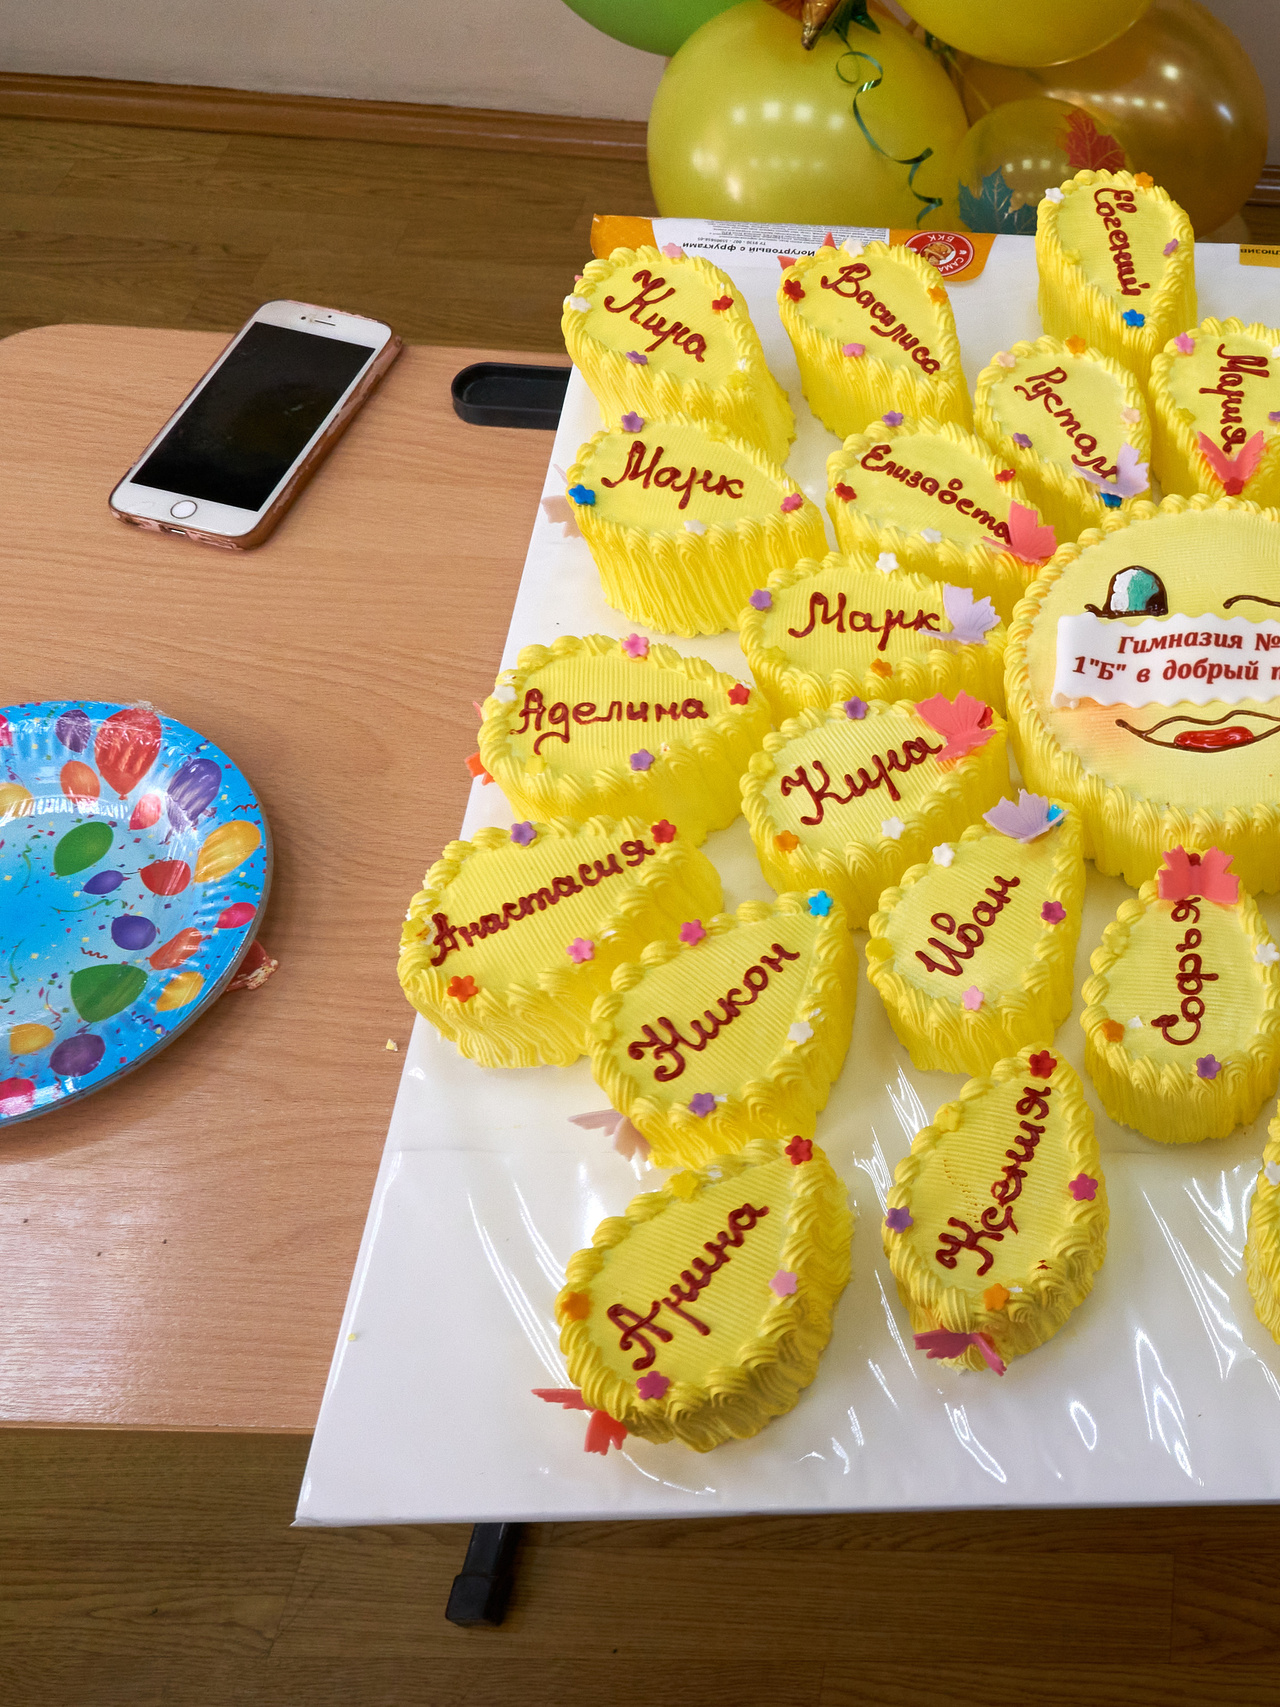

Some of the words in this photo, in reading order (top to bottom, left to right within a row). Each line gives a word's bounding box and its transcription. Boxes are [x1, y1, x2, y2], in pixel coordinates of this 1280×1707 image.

[682, 242, 737, 252] фруктами
[928, 234, 955, 243] БКК
[1095, 189, 1149, 295] Евгений
[605, 270, 706, 361] Кира
[821, 263, 941, 374] Василиса
[1015, 368, 1118, 479] Рустам
[1200, 344, 1269, 453] Мария
[602, 441, 743, 509] Марк
[861, 445, 1013, 546] Елизавета
[789, 592, 939, 650] Марк
[1072, 656, 1127, 681] 1"Б"
[1136, 667, 1151, 683] в
[1162, 657, 1260, 685] добрый
[1117, 631, 1244, 655] Гимназия
[510, 689, 708, 754] Аделина
[781, 738, 942, 825] Кира
[431, 840, 654, 966] Анастасия
[916, 876, 1020, 976] Иван
[629, 942, 799, 1081] Никон
[1151, 897, 1218, 1045] Софья
[936, 1087, 1050, 1275] Ксения
[608, 1204, 768, 1371] Арина
